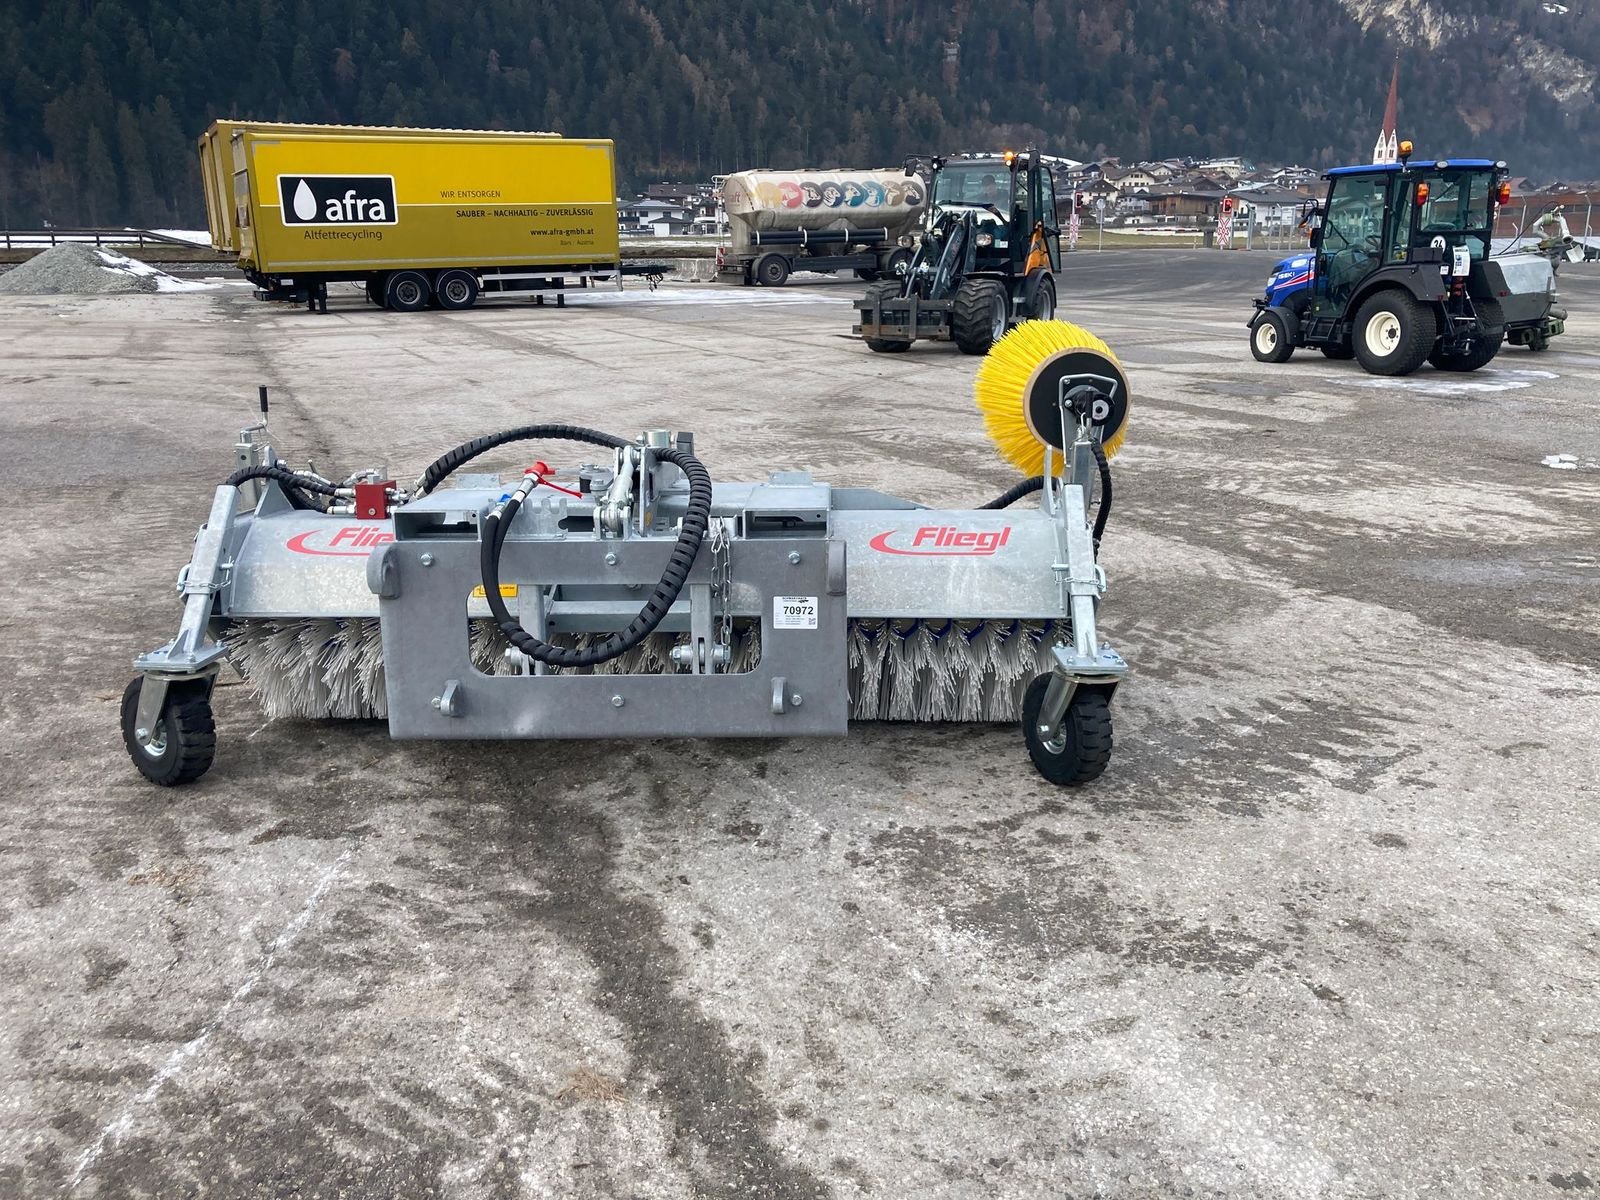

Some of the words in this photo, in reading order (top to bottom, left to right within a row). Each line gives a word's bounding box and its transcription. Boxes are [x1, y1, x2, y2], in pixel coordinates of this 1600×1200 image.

[440, 190, 455, 198] WIR
[457, 190, 501, 198] ENTSORGEN
[325, 189, 387, 221] afra
[456, 209, 486, 218] SAUBER
[493, 209, 539, 217] NACHHALTIG
[545, 207, 594, 216] ZUVERLÄSSIG
[304, 229, 383, 241] Altfettrecycling
[530, 228, 594, 236] www.afra-gmbh.at
[329, 527, 396, 547] Flie
[912, 527, 1012, 552] Fliegl
[783, 605, 814, 615] 70972
